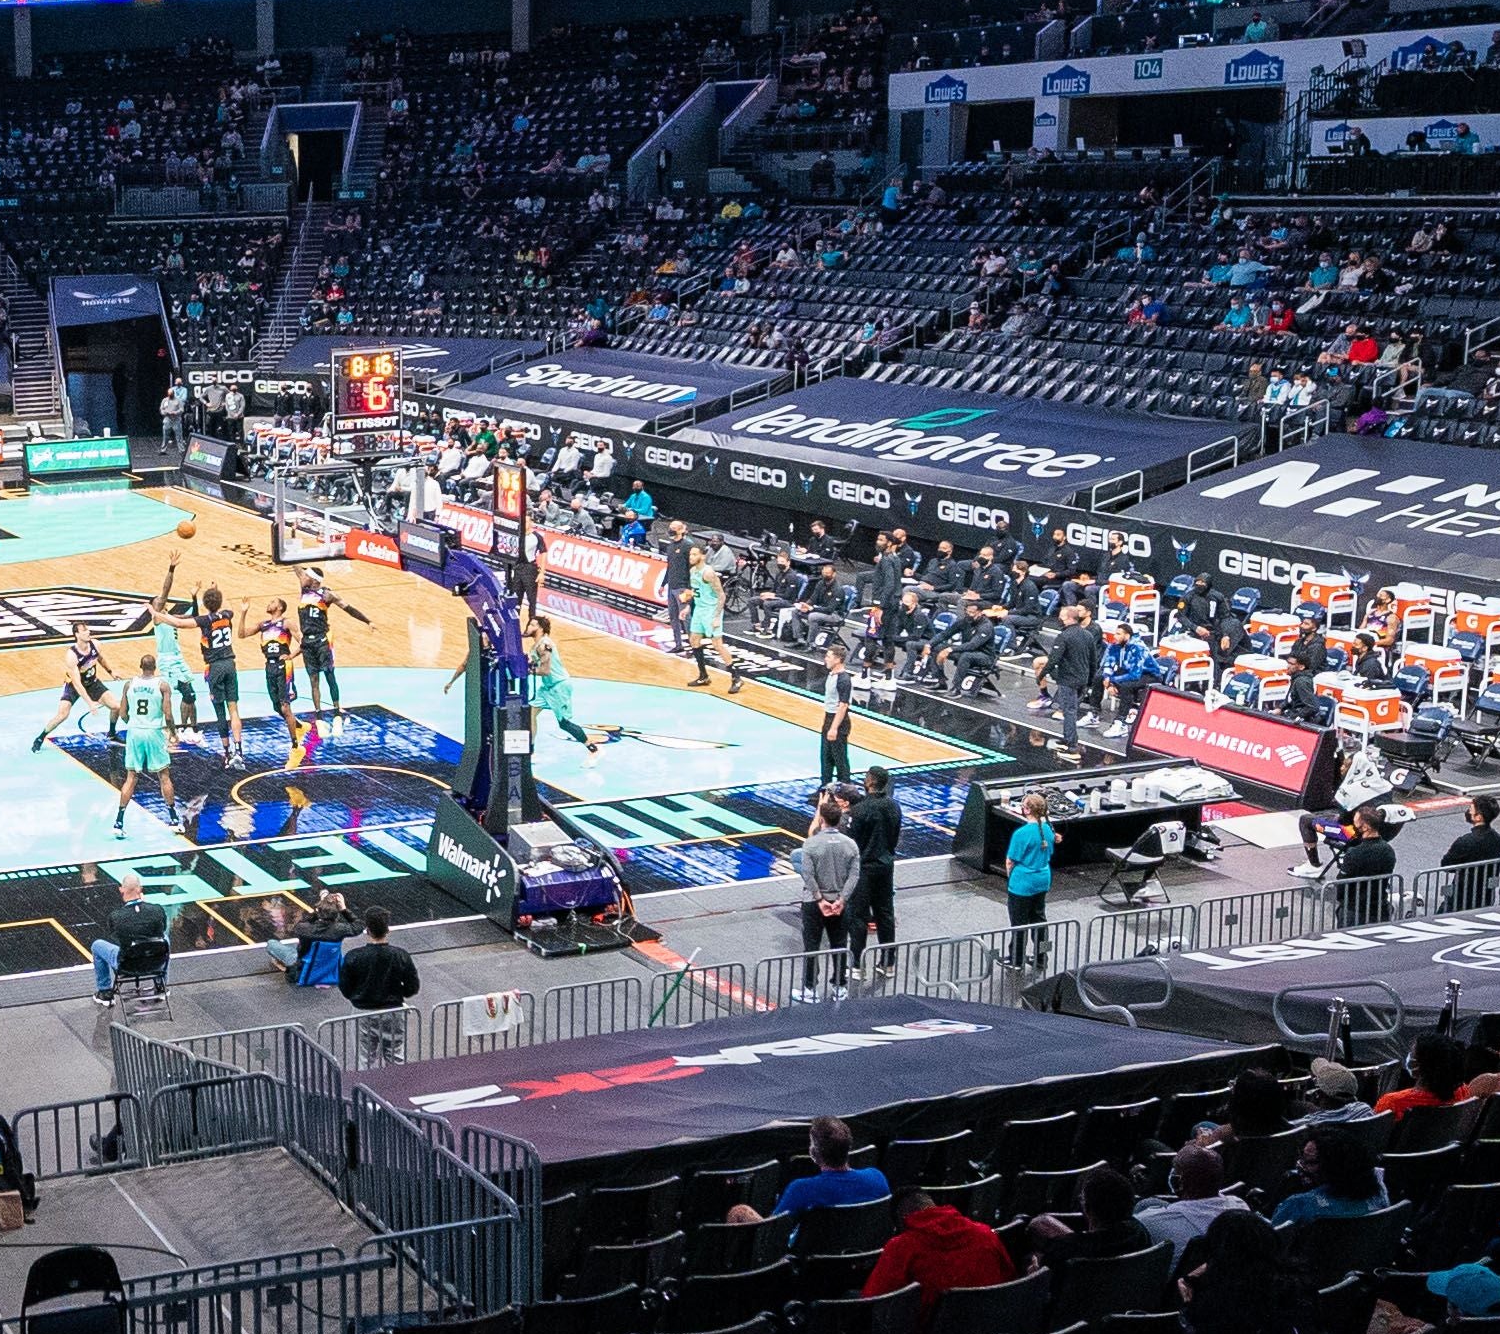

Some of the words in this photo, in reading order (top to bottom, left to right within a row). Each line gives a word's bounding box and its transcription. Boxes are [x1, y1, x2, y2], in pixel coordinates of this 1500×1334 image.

[1135, 58, 1163, 78] 104
[1228, 62, 1278, 84] LOWE'S
[926, 88, 964, 103] LOWE'S
[1046, 75, 1088, 95] LOWE'S
[187, 369, 254, 385] GEICO
[350, 355, 394, 378] 8:16
[253, 378, 309, 395] GEICO
[366, 376, 388, 411] 6
[505, 363, 695, 405] Spectrum
[353, 415, 400, 430] TISSOT
[731, 403, 1102, 481] lendingtree
[645, 446, 693, 470] GEICO
[730, 462, 786, 488] GEICO
[827, 478, 890, 510] GEICO
[936, 498, 1009, 531] GEICO
[546, 535, 649, 592] GATORADE
[308, 607, 320, 618] 12
[211, 627, 232, 648] 23
[267, 643, 280, 653] 25
[136, 699, 149, 715] 8
[1147, 713, 1186, 737] BANK
[1187, 722, 1206, 743] OF
[1206, 731, 1272, 762] AMERICA
[436, 830, 492, 887] Walmart
